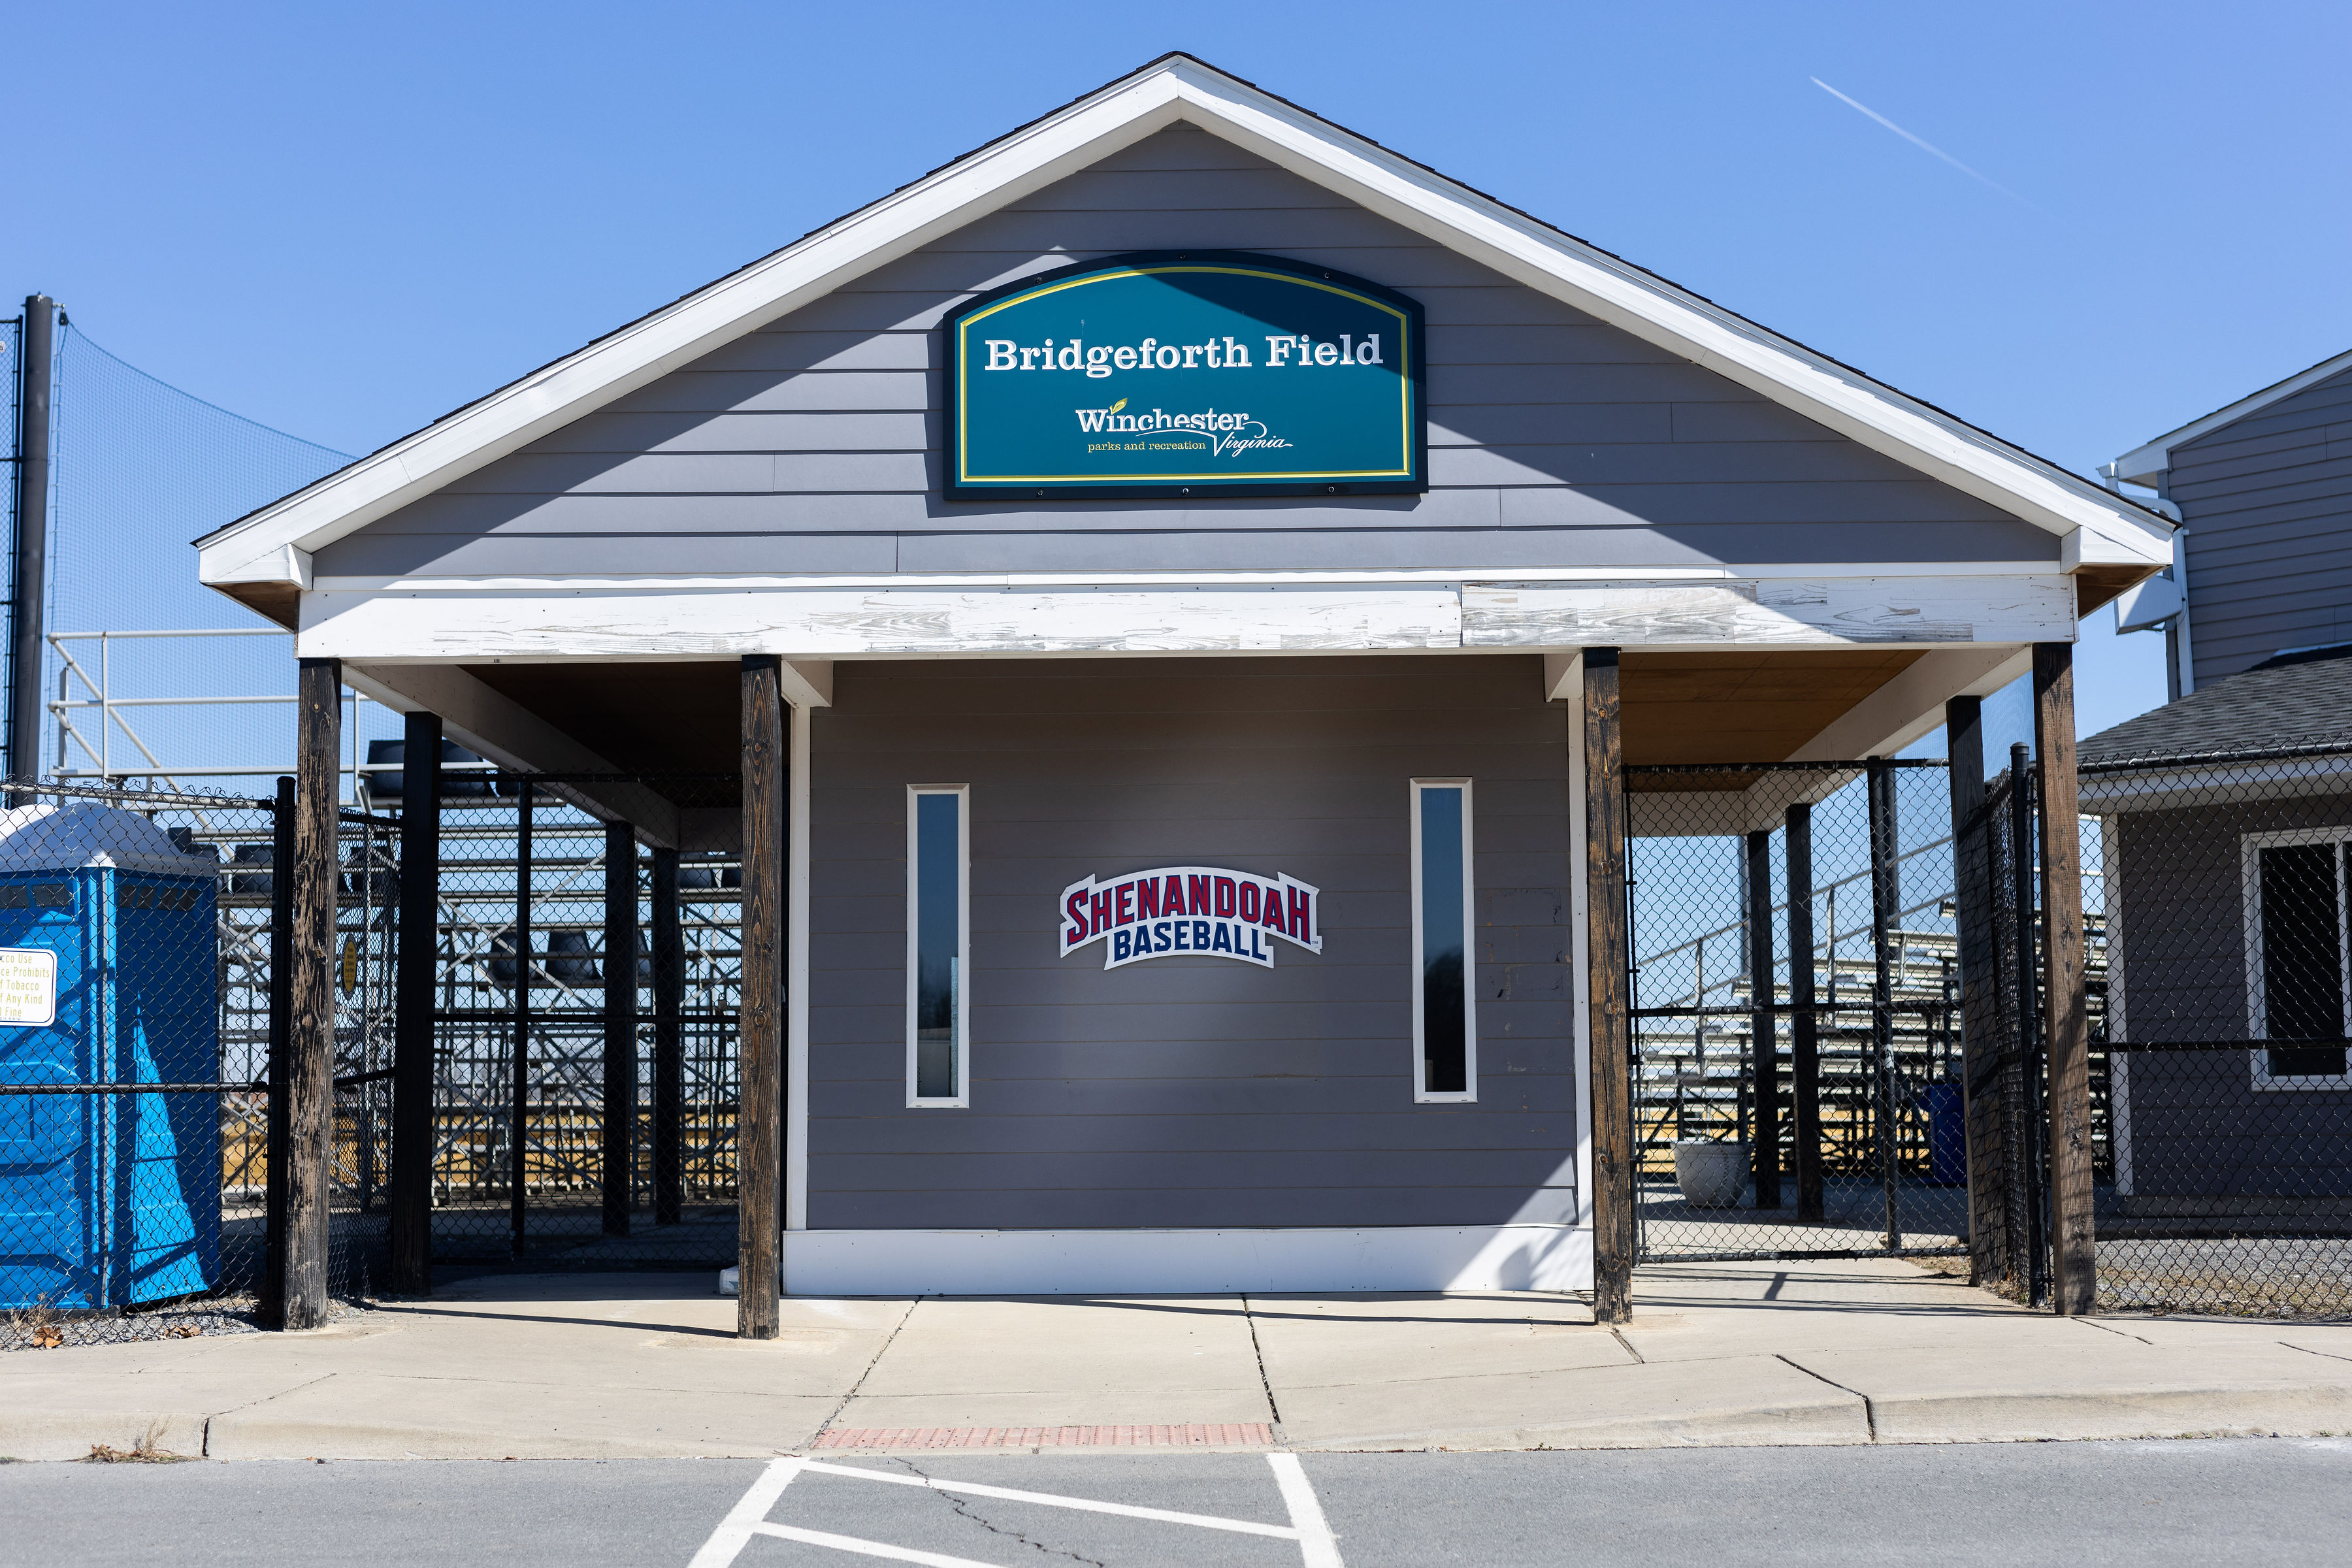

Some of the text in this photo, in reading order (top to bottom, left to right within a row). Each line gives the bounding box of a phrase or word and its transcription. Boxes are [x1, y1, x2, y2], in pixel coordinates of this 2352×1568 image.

[985, 334, 1384, 378] Bridgeforth Field
[1075, 406, 1250, 433] Winchester
[1088, 440, 1206, 453] parks and recreation
[1213, 431, 1294, 457] Virginia
[1066, 874, 1311, 948] SHENANDOAH
[1113, 920, 1267, 962] BASEBALL
[18, 953, 32, 964] Use
[13, 966, 50, 978] Prohibits
[7, 979, 39, 991] Tobacco
[6, 993, 22, 1007] Any
[25, 994, 42, 1004] Kind
[5, 1007, 22, 1017] Fine
